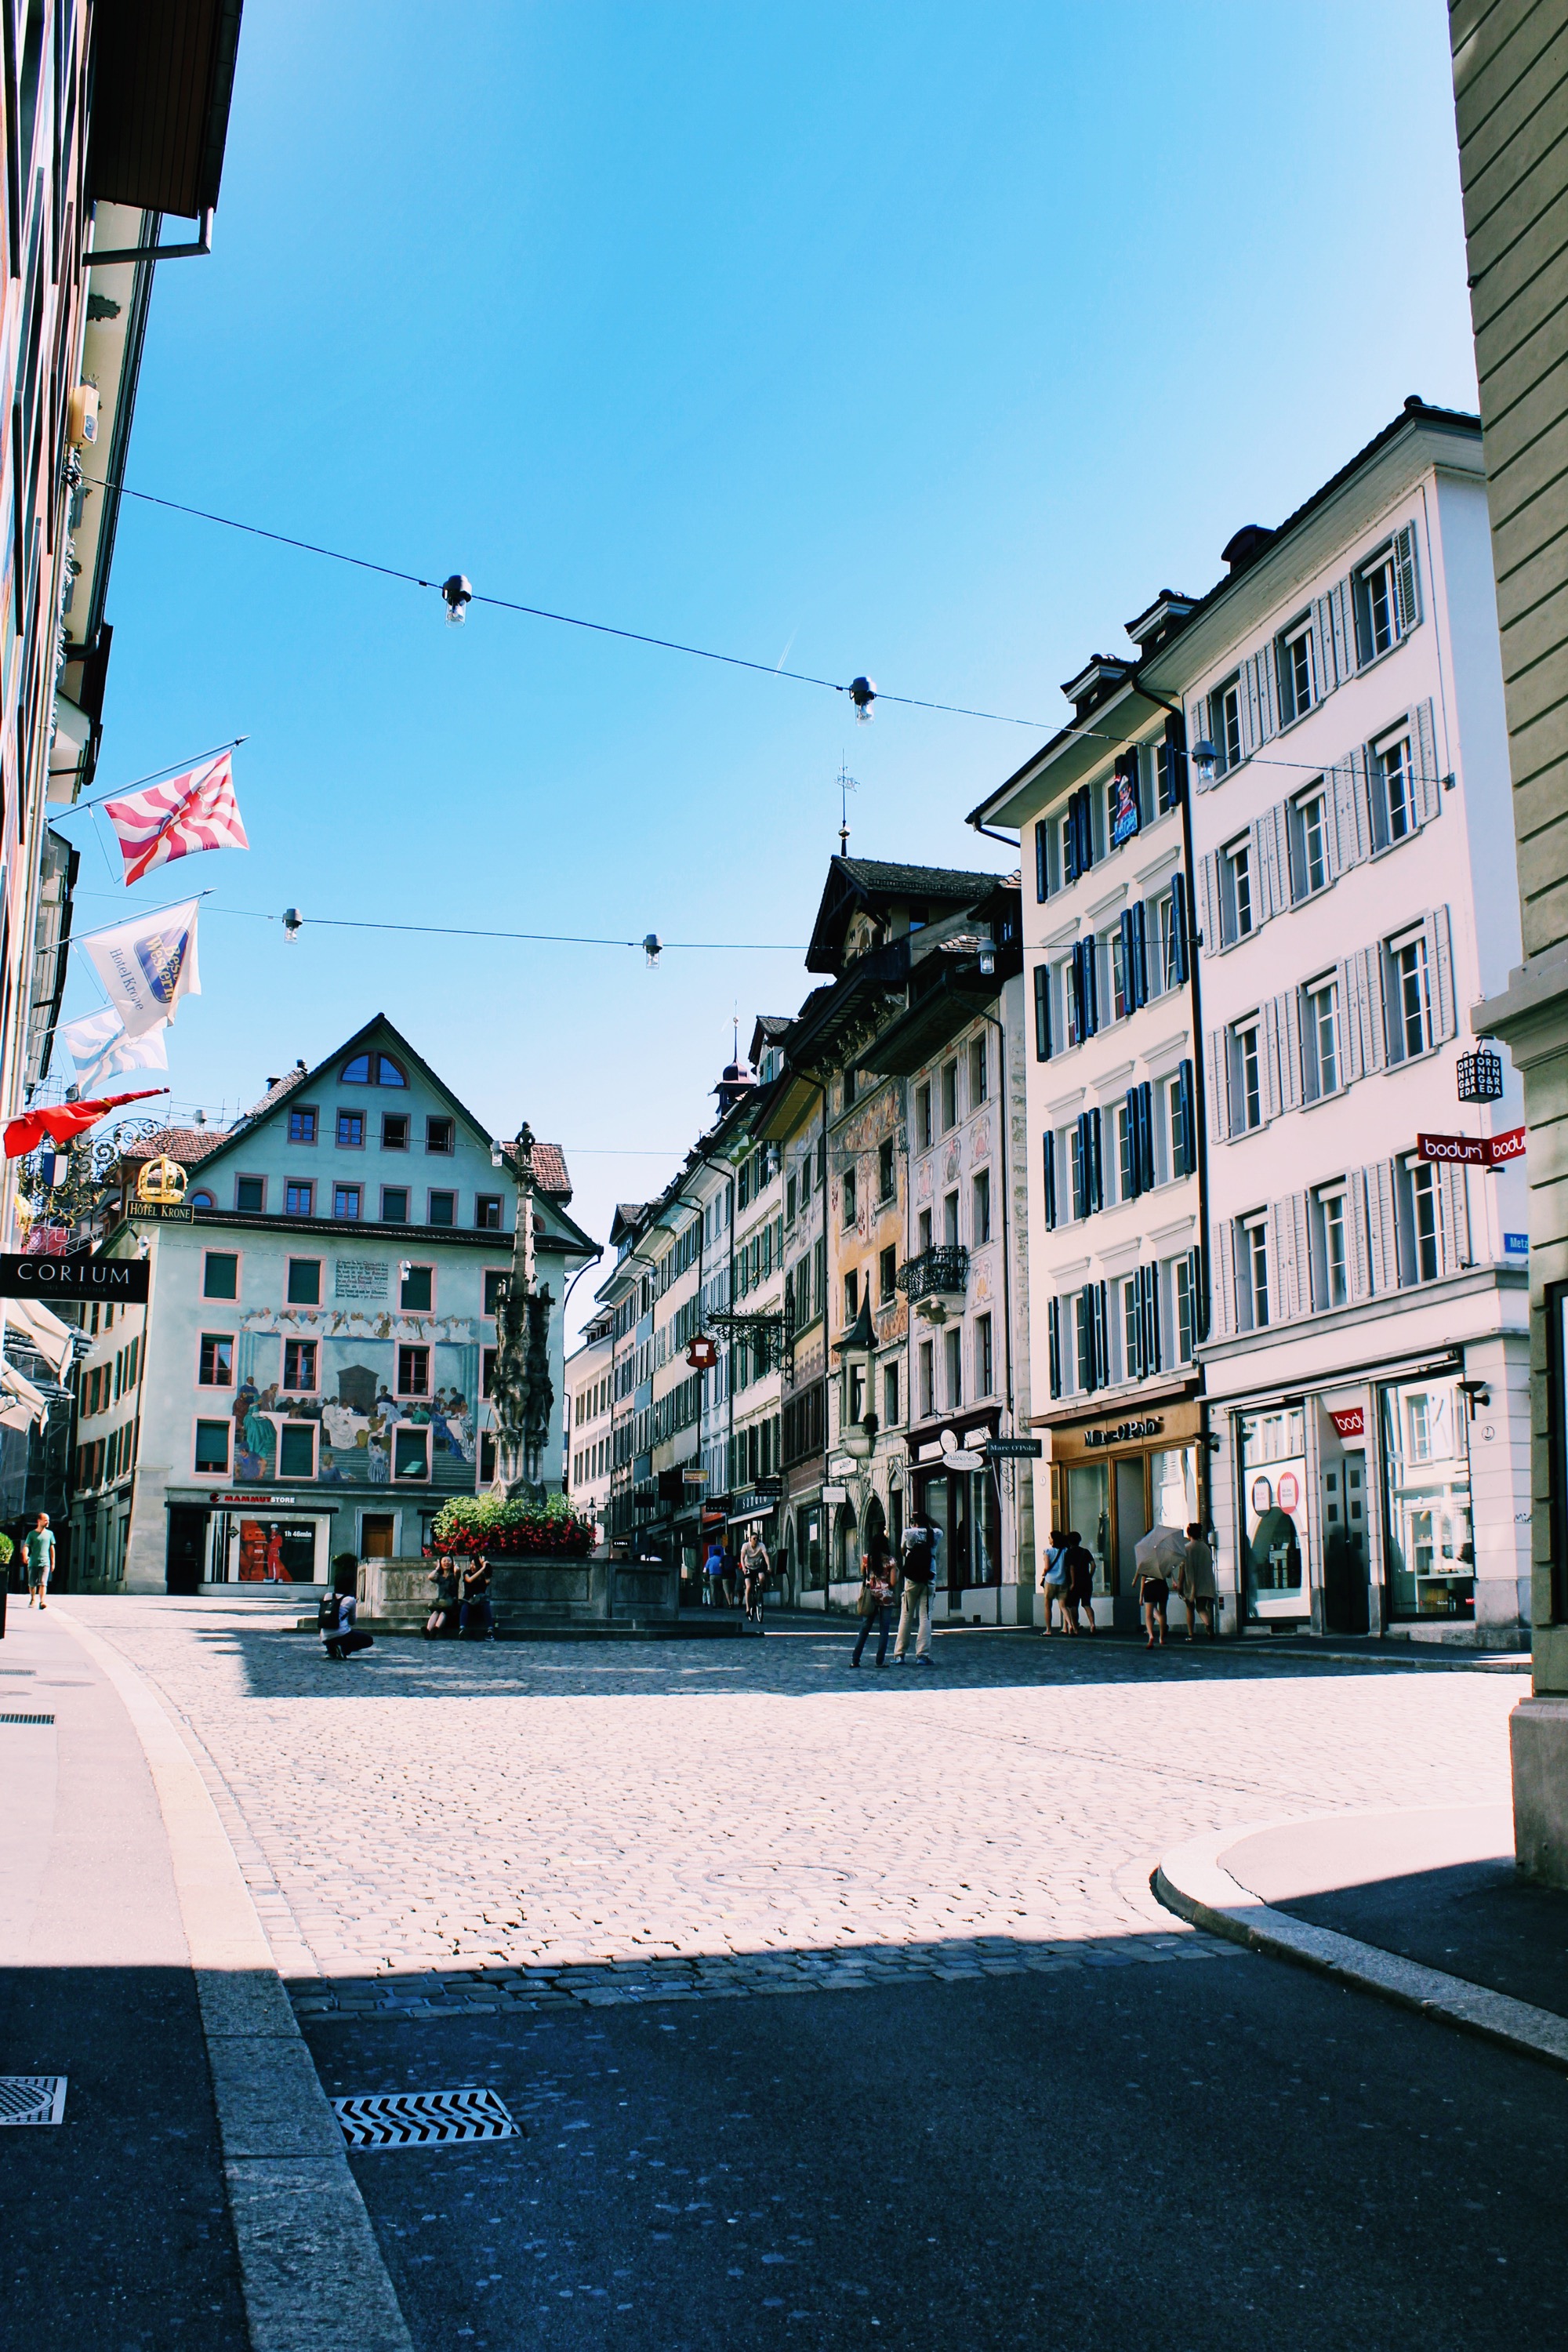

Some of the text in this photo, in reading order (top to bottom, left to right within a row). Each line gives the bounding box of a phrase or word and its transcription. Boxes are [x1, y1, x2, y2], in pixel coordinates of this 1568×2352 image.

[146, 935, 174, 999] Western
[110, 948, 144, 1011] Hotel Krone
[1425, 1139, 1483, 1160] bodum
[1493, 1134, 1526, 1157] bodu
[17, 1263, 130, 1284] CORIUM
